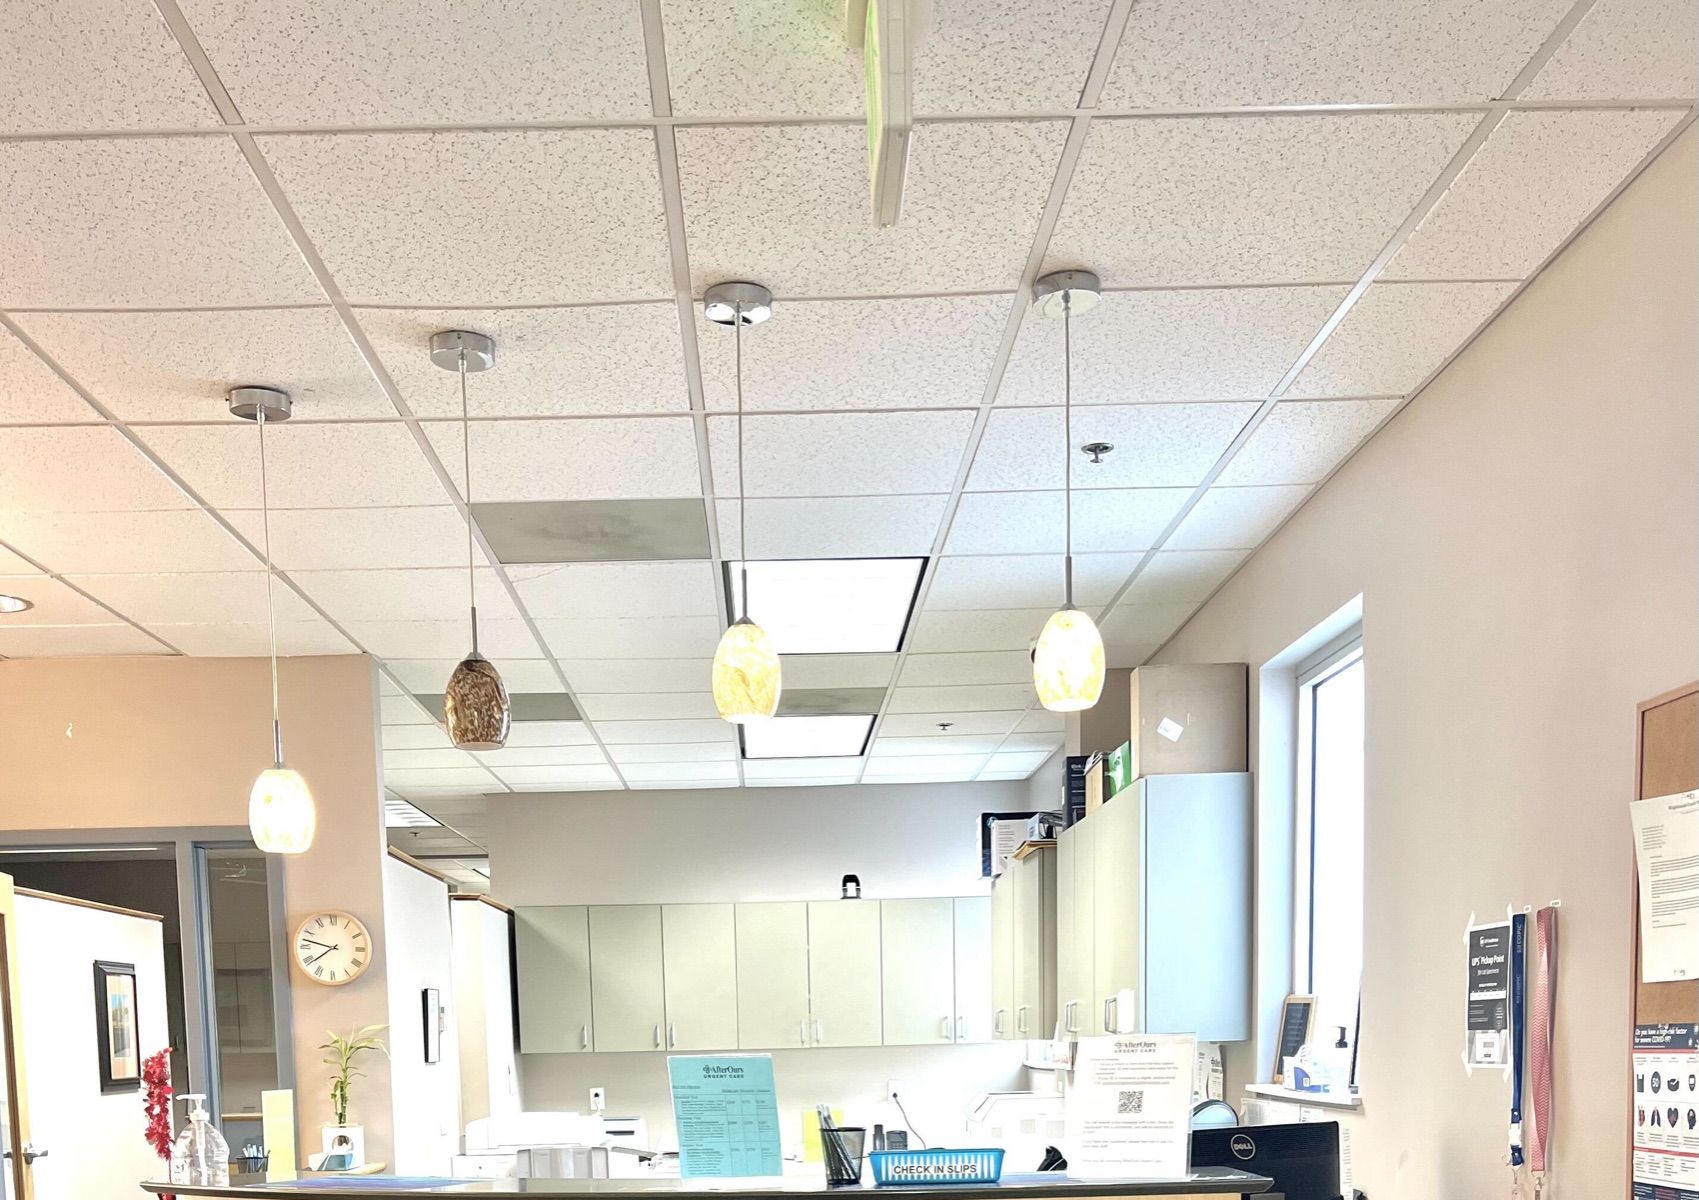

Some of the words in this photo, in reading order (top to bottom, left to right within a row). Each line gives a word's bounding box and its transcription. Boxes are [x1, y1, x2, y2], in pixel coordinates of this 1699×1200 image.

[711, 1065, 744, 1074] AfterOurs
[893, 1165, 931, 1174] CHECK
[934, 1164, 944, 1174] IN
[947, 1164, 977, 1174] SLIPS
